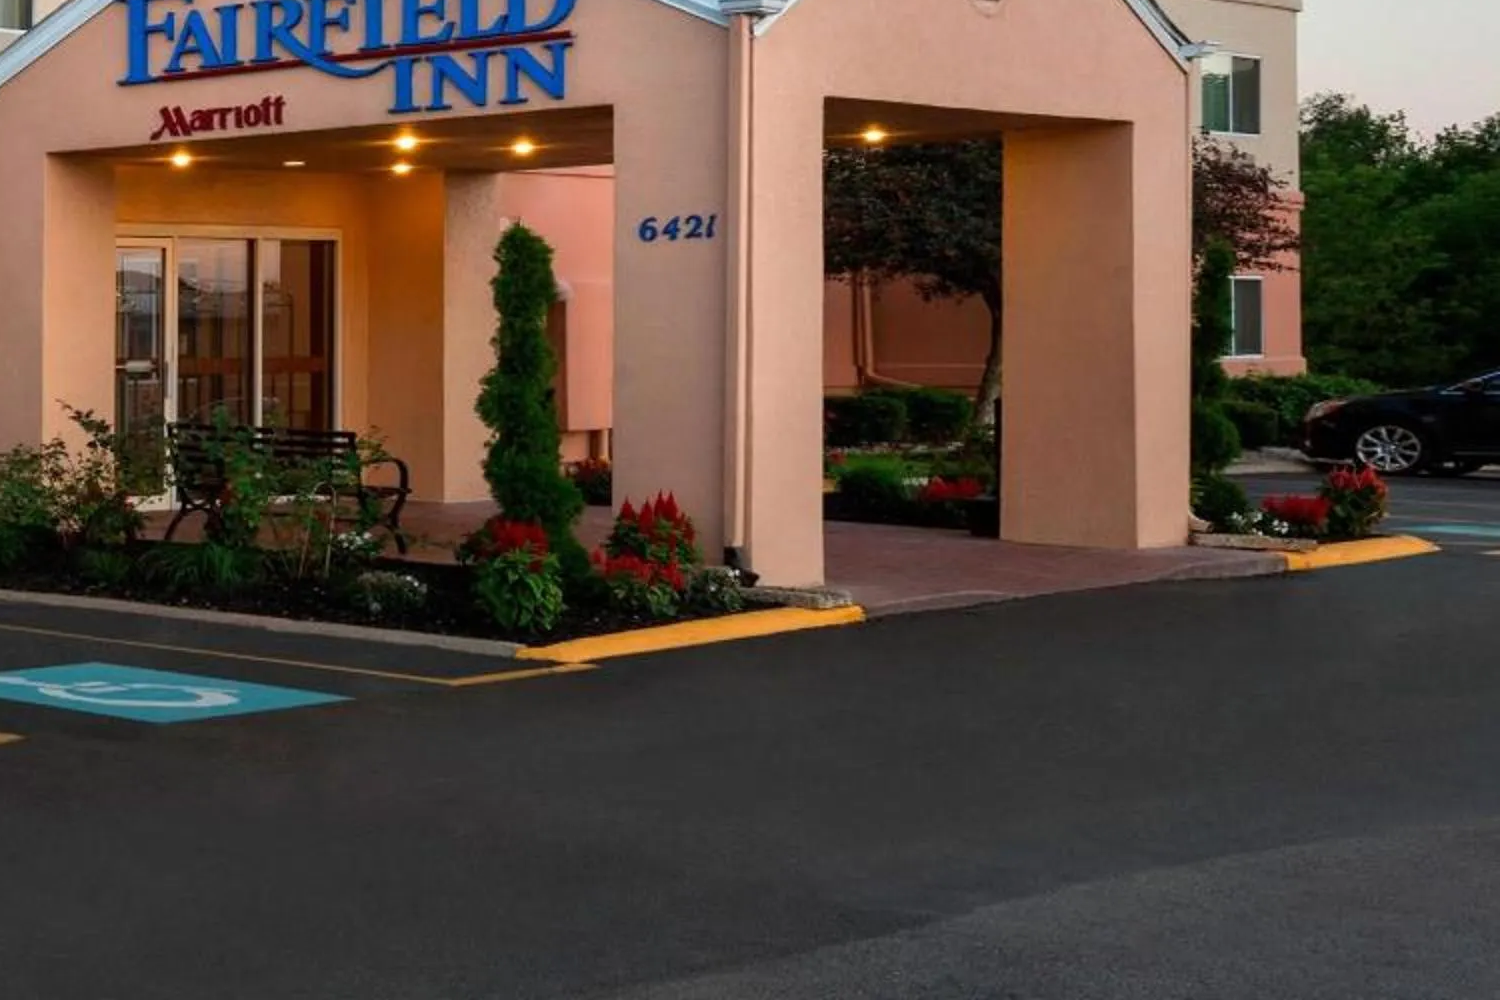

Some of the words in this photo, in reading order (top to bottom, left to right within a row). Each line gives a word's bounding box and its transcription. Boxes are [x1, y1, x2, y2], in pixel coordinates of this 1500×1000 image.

[388, 41, 573, 114] INN
[151, 95, 286, 140] Marriott
[638, 214, 717, 242] 6421
